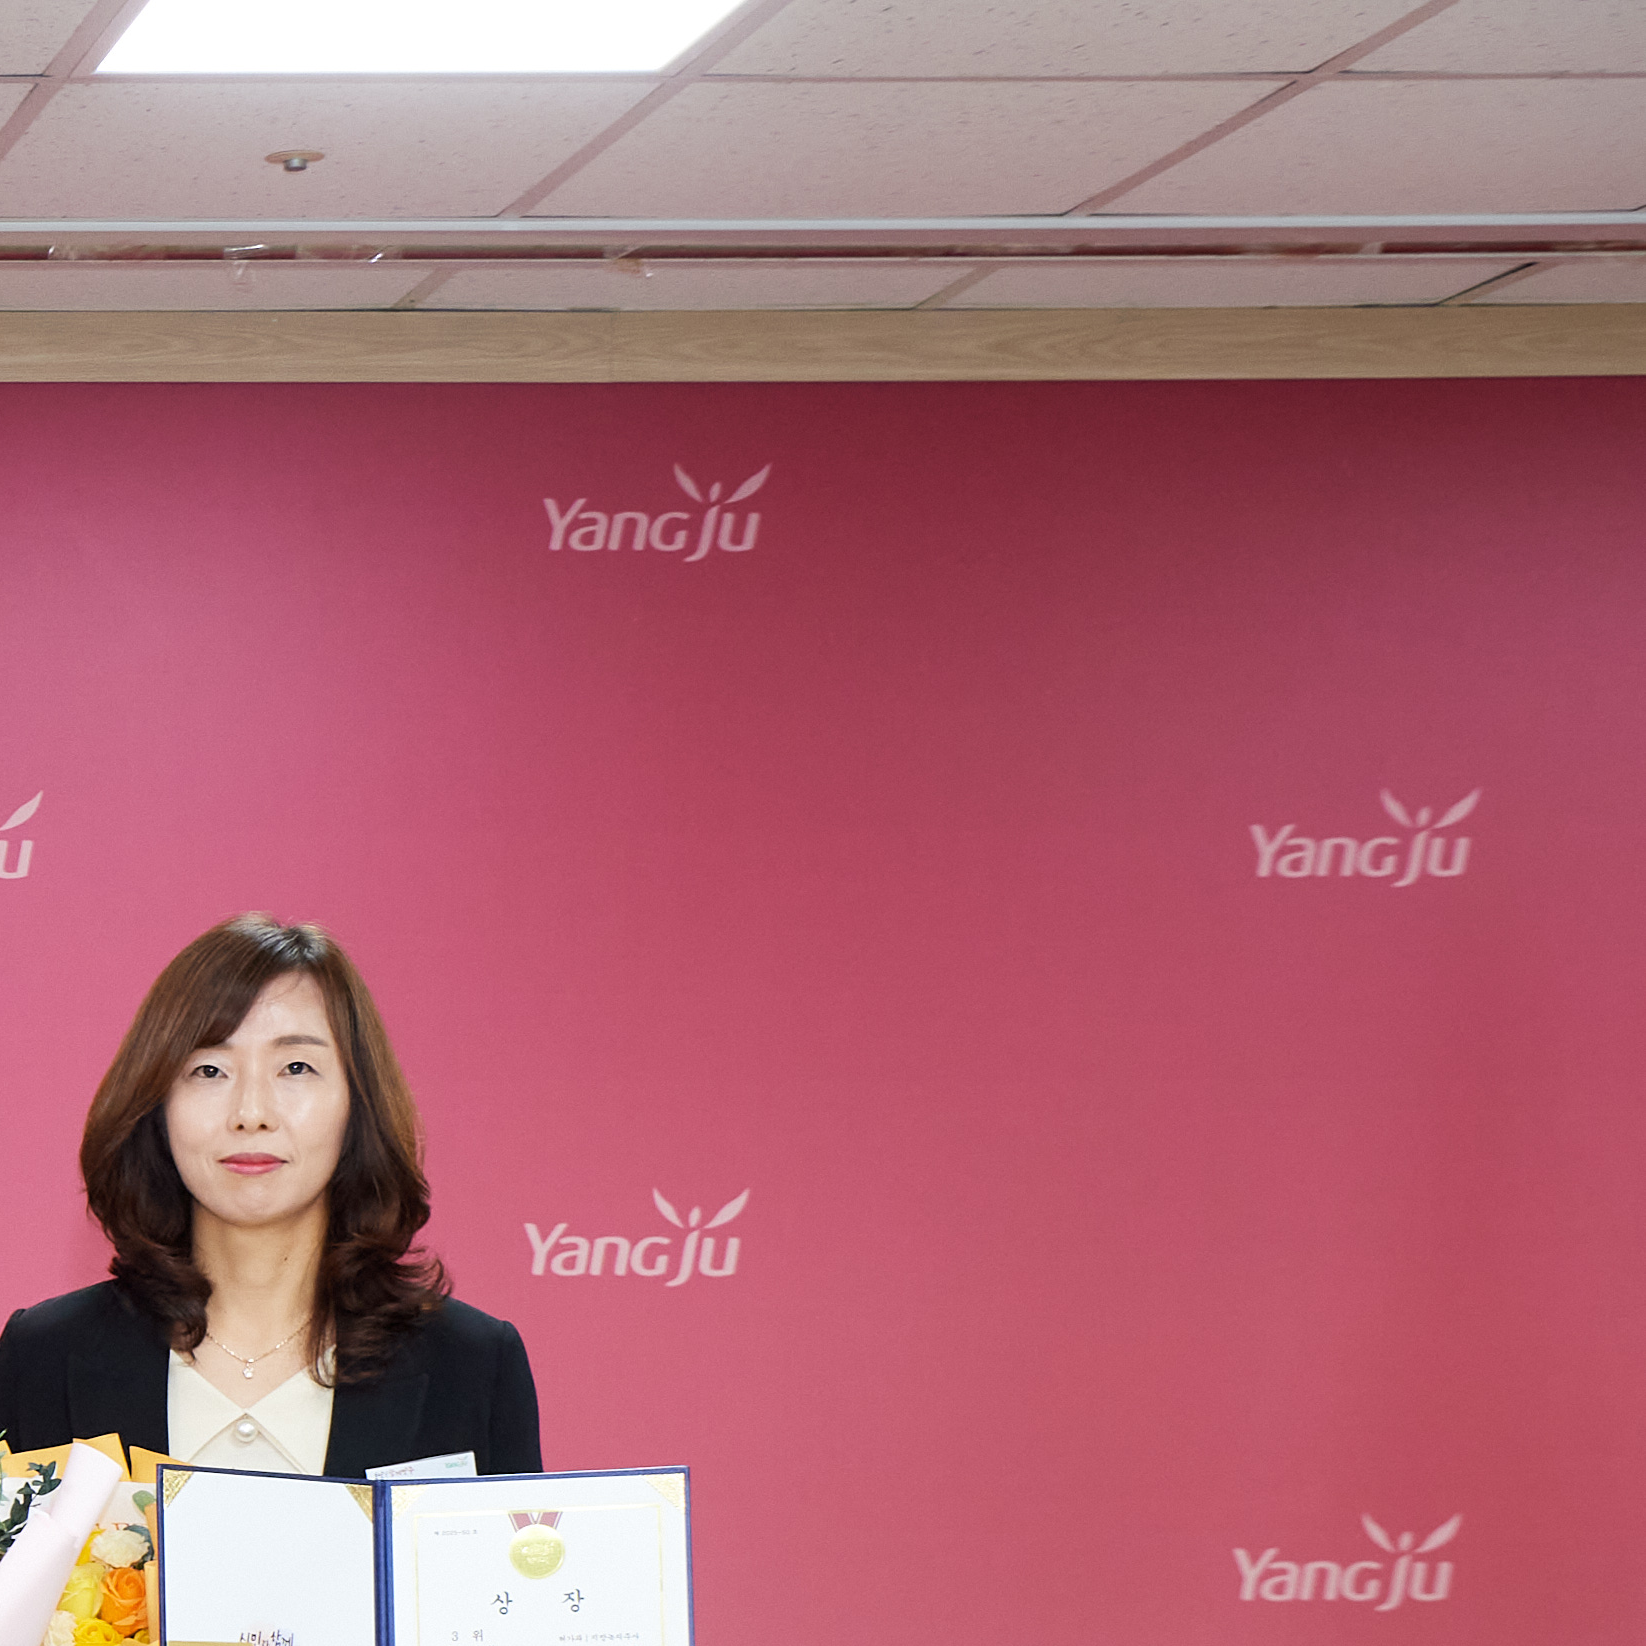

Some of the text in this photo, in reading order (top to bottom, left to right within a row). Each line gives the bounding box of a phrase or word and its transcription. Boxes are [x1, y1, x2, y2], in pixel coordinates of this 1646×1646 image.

[490, 1589, 584, 1615] 상 장
[451, 1629, 483, 1642] 3 위
